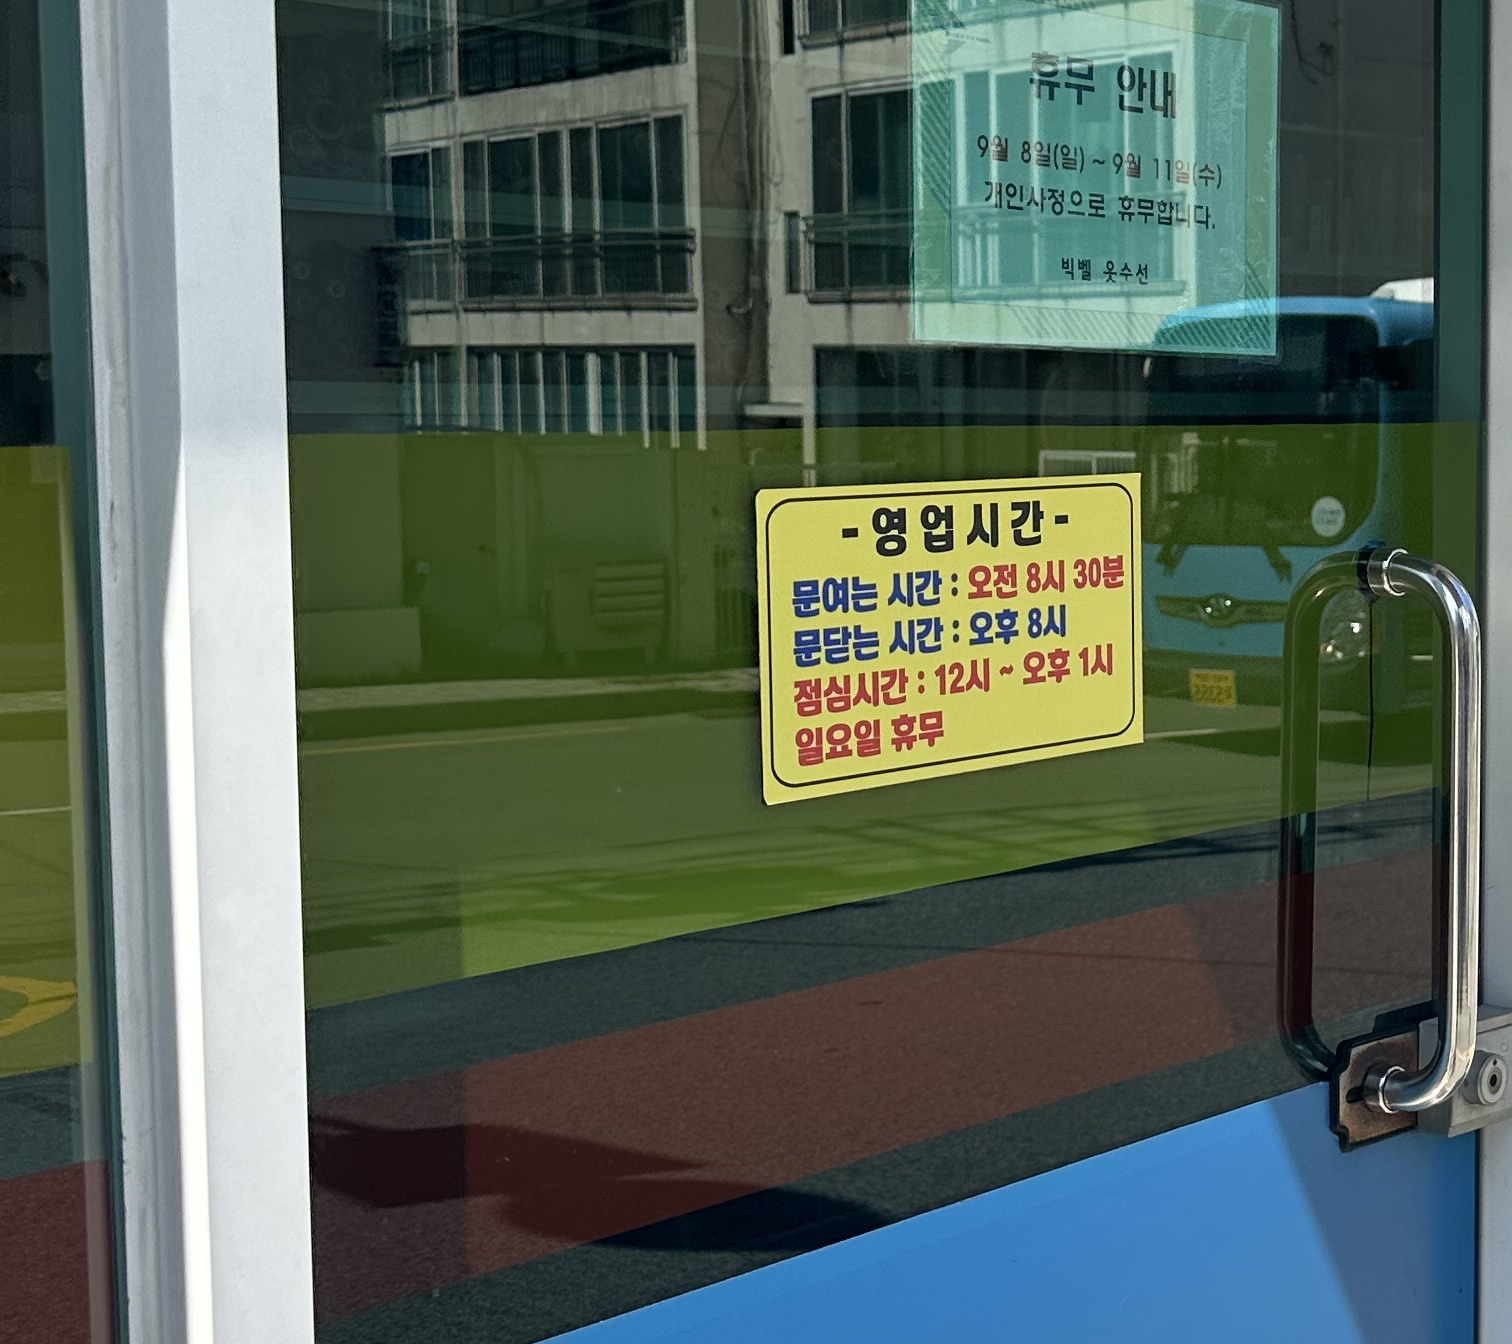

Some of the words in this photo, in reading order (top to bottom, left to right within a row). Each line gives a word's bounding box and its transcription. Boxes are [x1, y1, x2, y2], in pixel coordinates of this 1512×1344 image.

[1029, 51, 1095, 105] 휴무
[1117, 64, 1177, 119] 안내
[977, 134, 1009, 163] 9월
[1113, 151, 1142, 179] 9월
[984, 181, 1107, 220] 개인사정으로
[1117, 193, 1217, 231] 휴무합니다.
[1061, 257, 1093, 282] 빅벨
[1103, 260, 1150, 286] 옷수선
[792, 577, 878, 618] 문여는
[887, 570, 943, 608] 시간
[968, 563, 1018, 600] 오전
[1026, 560, 1066, 593] 8시
[1073, 554, 1125, 589] 30분
[793, 624, 879, 668] 문닫는
[889, 617, 943, 654] 시간
[969, 609, 1019, 646] 오후
[1027, 604, 1067, 638] 8시
[794, 668, 908, 717] 점심시간
[934, 658, 990, 695] 12시
[1022, 648, 1070, 685] 오후
[1078, 643, 1114, 677] 1시
[795, 719, 881, 767] 일요일
[890, 710, 944, 750] 휴무
